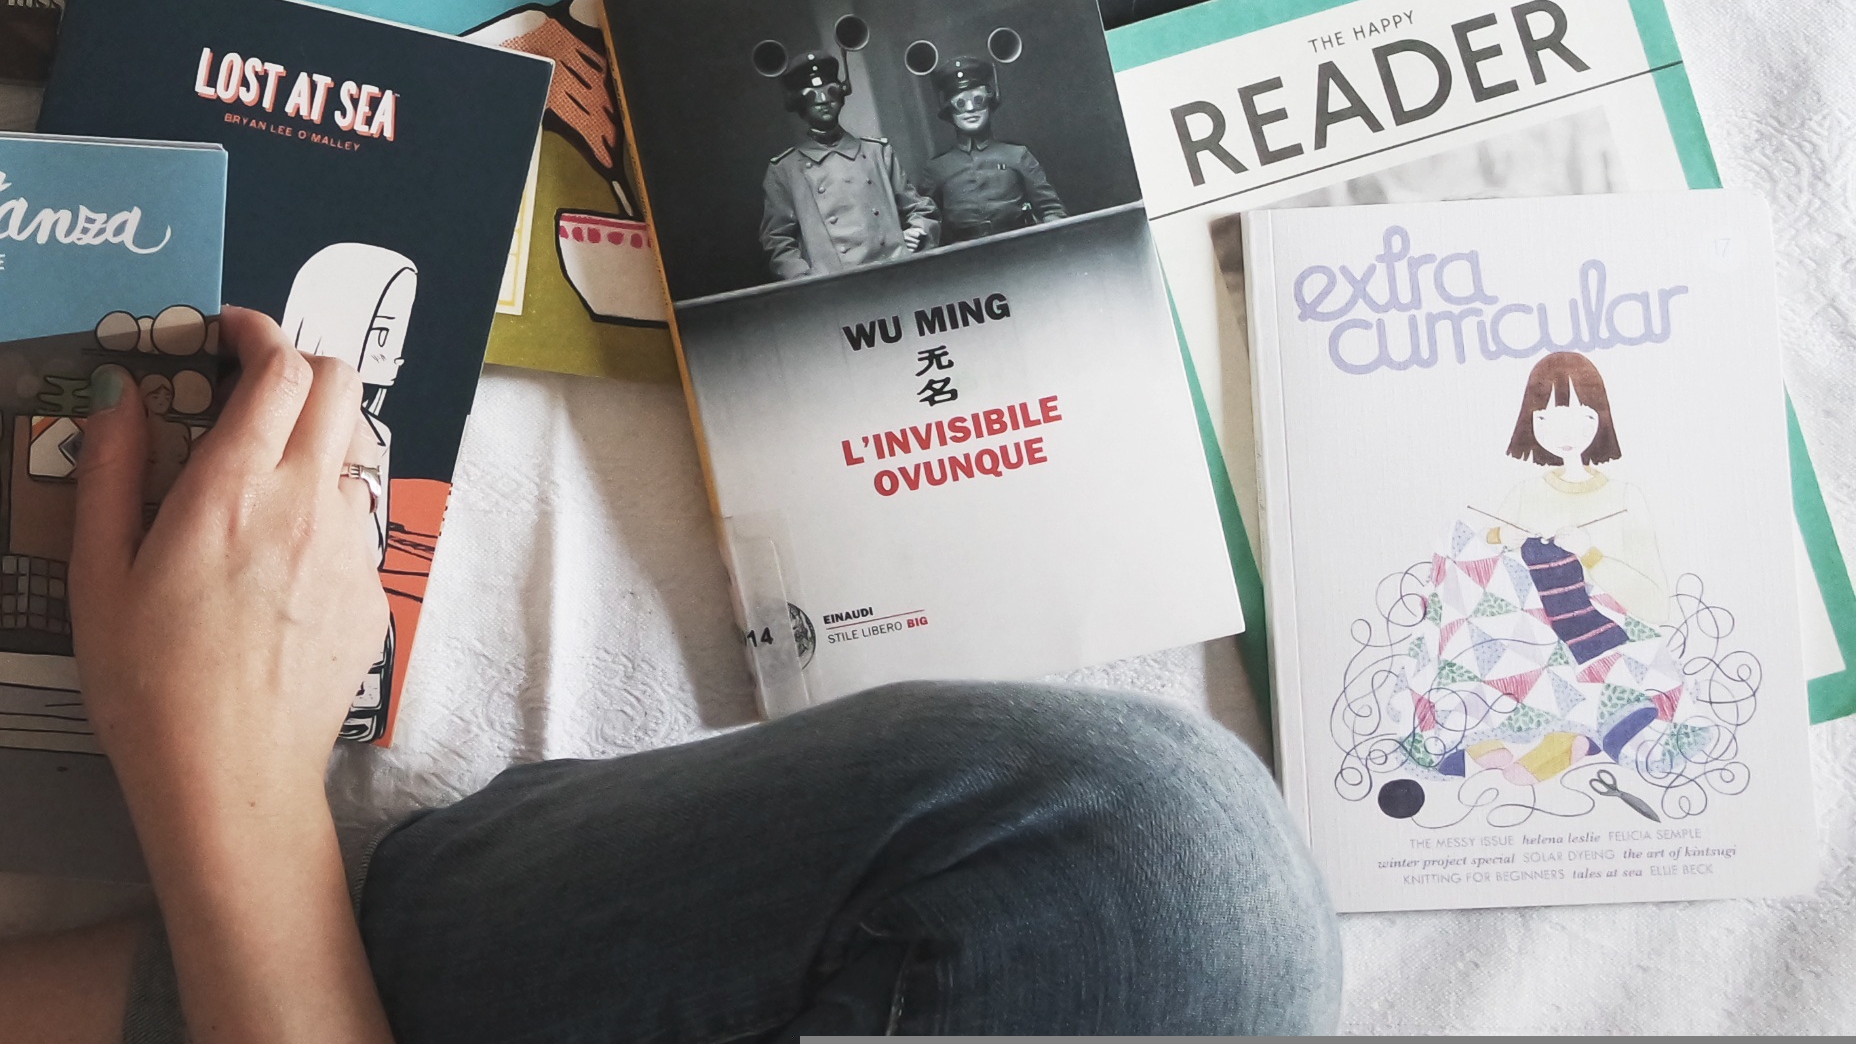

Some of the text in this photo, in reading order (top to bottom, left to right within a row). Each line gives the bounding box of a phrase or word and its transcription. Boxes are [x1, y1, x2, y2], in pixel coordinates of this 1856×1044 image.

[1308, 10, 1413, 53] THE HAPPY
[195, 47, 396, 142] LOST AT SEA
[224, 113, 267, 130] BRYAN
[270, 124, 292, 137] LEE
[1293, 225, 1499, 322] extra
[843, 293, 1011, 351] WU MING
[842, 395, 1063, 466] L'INVISIBILE
[874, 437, 1048, 497] OVUNQUE
[823, 607, 874, 625] EINAUDI
[828, 617, 928, 644] STILE LIBERO BIG
[1378, 845, 1736, 869] winter project special the art kintsugi
[1436, 832, 1600, 847] MESSY ISSUE helena leslie
[1403, 868, 1642, 885] KNITTING BEGINNERS tales sea
